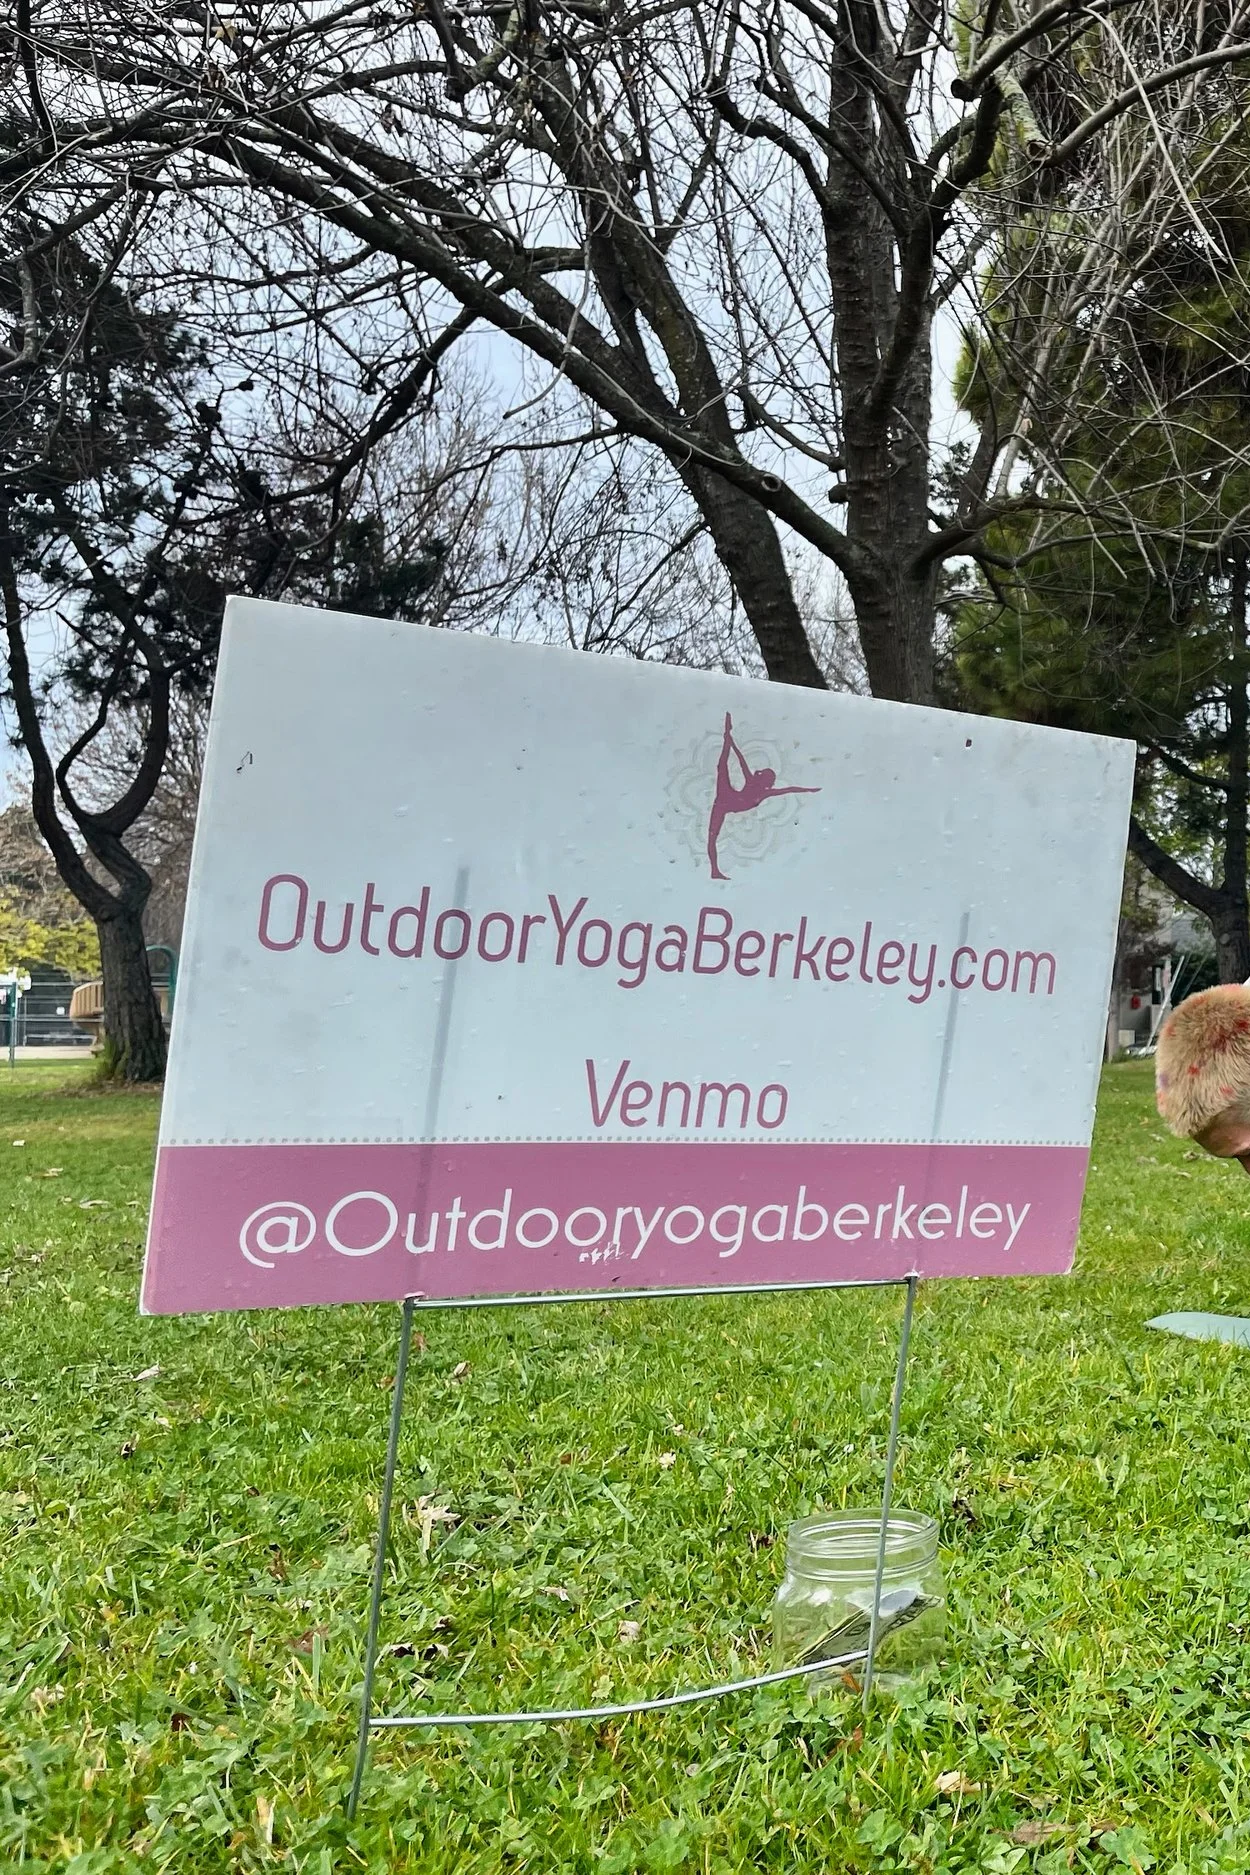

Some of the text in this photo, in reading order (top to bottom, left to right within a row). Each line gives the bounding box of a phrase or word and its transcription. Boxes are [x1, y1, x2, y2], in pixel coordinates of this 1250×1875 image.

[258, 873, 1057, 1005] OutdoorYogaBerkeley.com
[586, 1058, 789, 1129] Venmo
[238, 1184, 1031, 1268] @Outdooryogaberkeley
